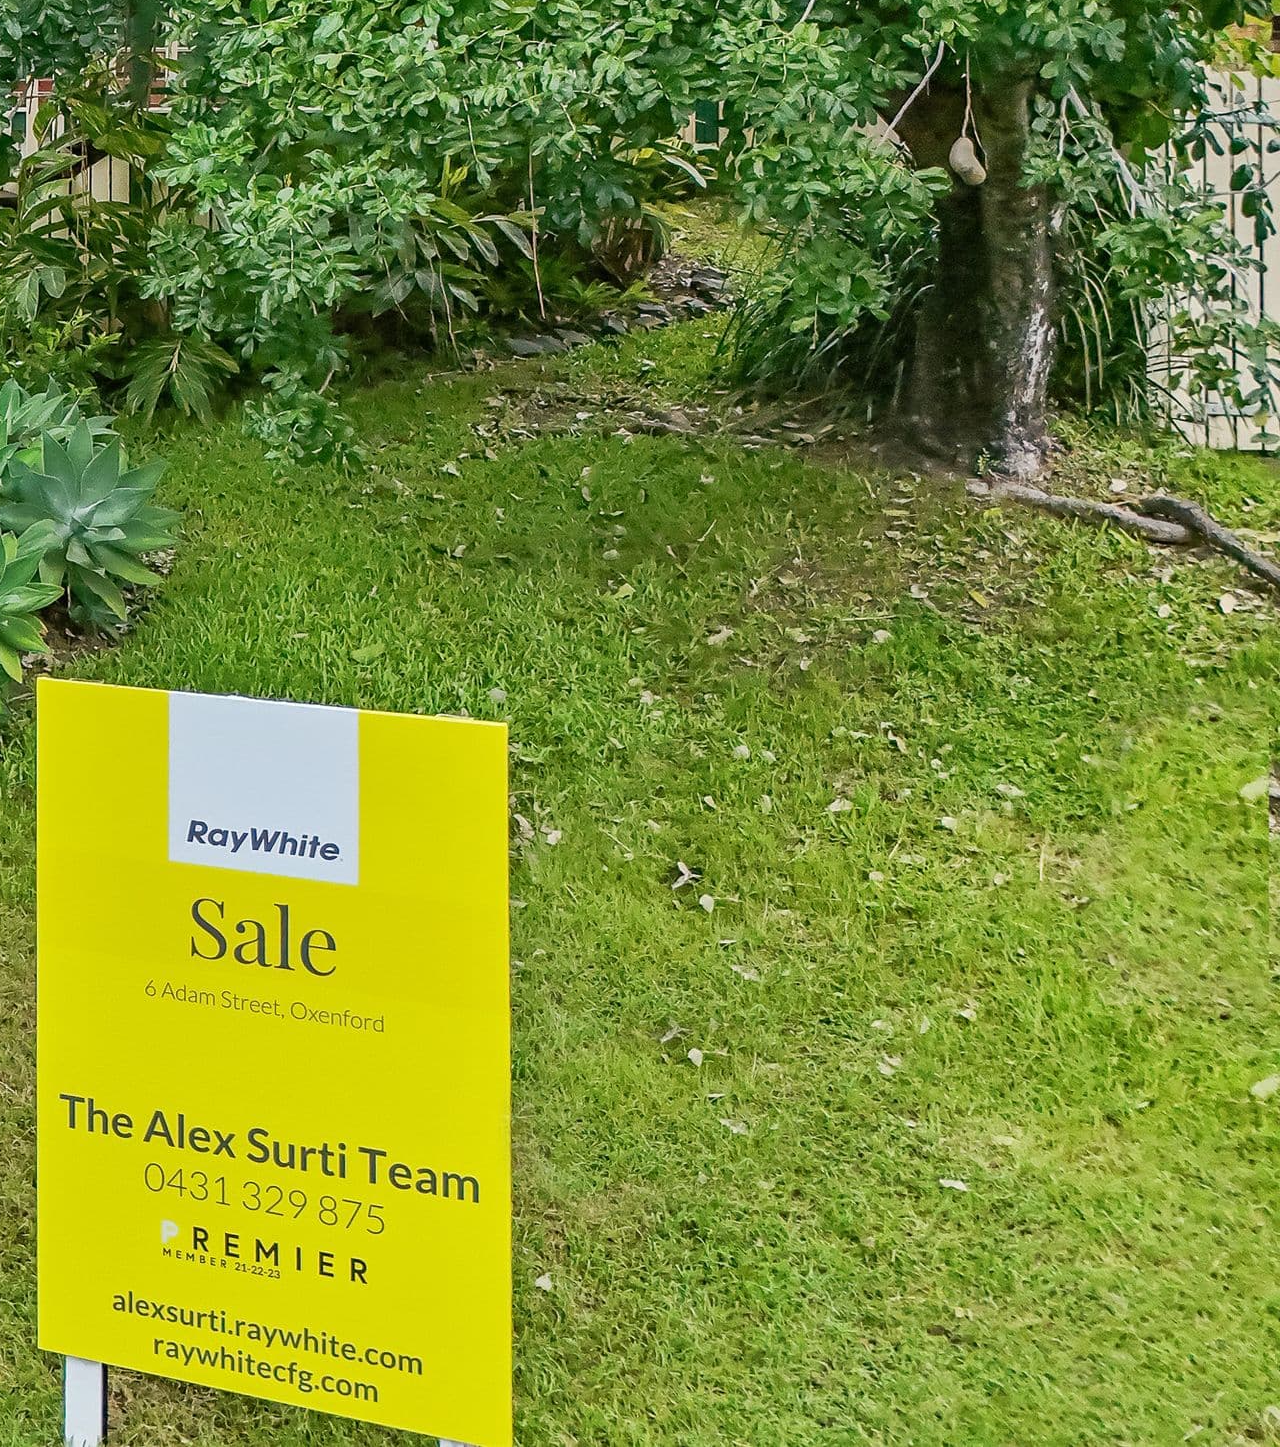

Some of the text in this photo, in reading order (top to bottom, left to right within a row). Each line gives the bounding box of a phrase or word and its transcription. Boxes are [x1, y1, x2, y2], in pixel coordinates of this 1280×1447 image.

[190, 898, 337, 977] Sale
[144, 979, 386, 1034] 6 Adam Street, Oxenford
[58, 1092, 481, 1204] The Alex Surti Team
[144, 1162, 386, 1235] 0431 329 875
[160, 1219, 369, 1285] PREMIER
[162, 1247, 282, 1280] MEMBER 21-22-23
[112, 1290, 424, 1376] alexsurti.raywhite.com
[153, 1334, 380, 1404] raywhitecfg.com
